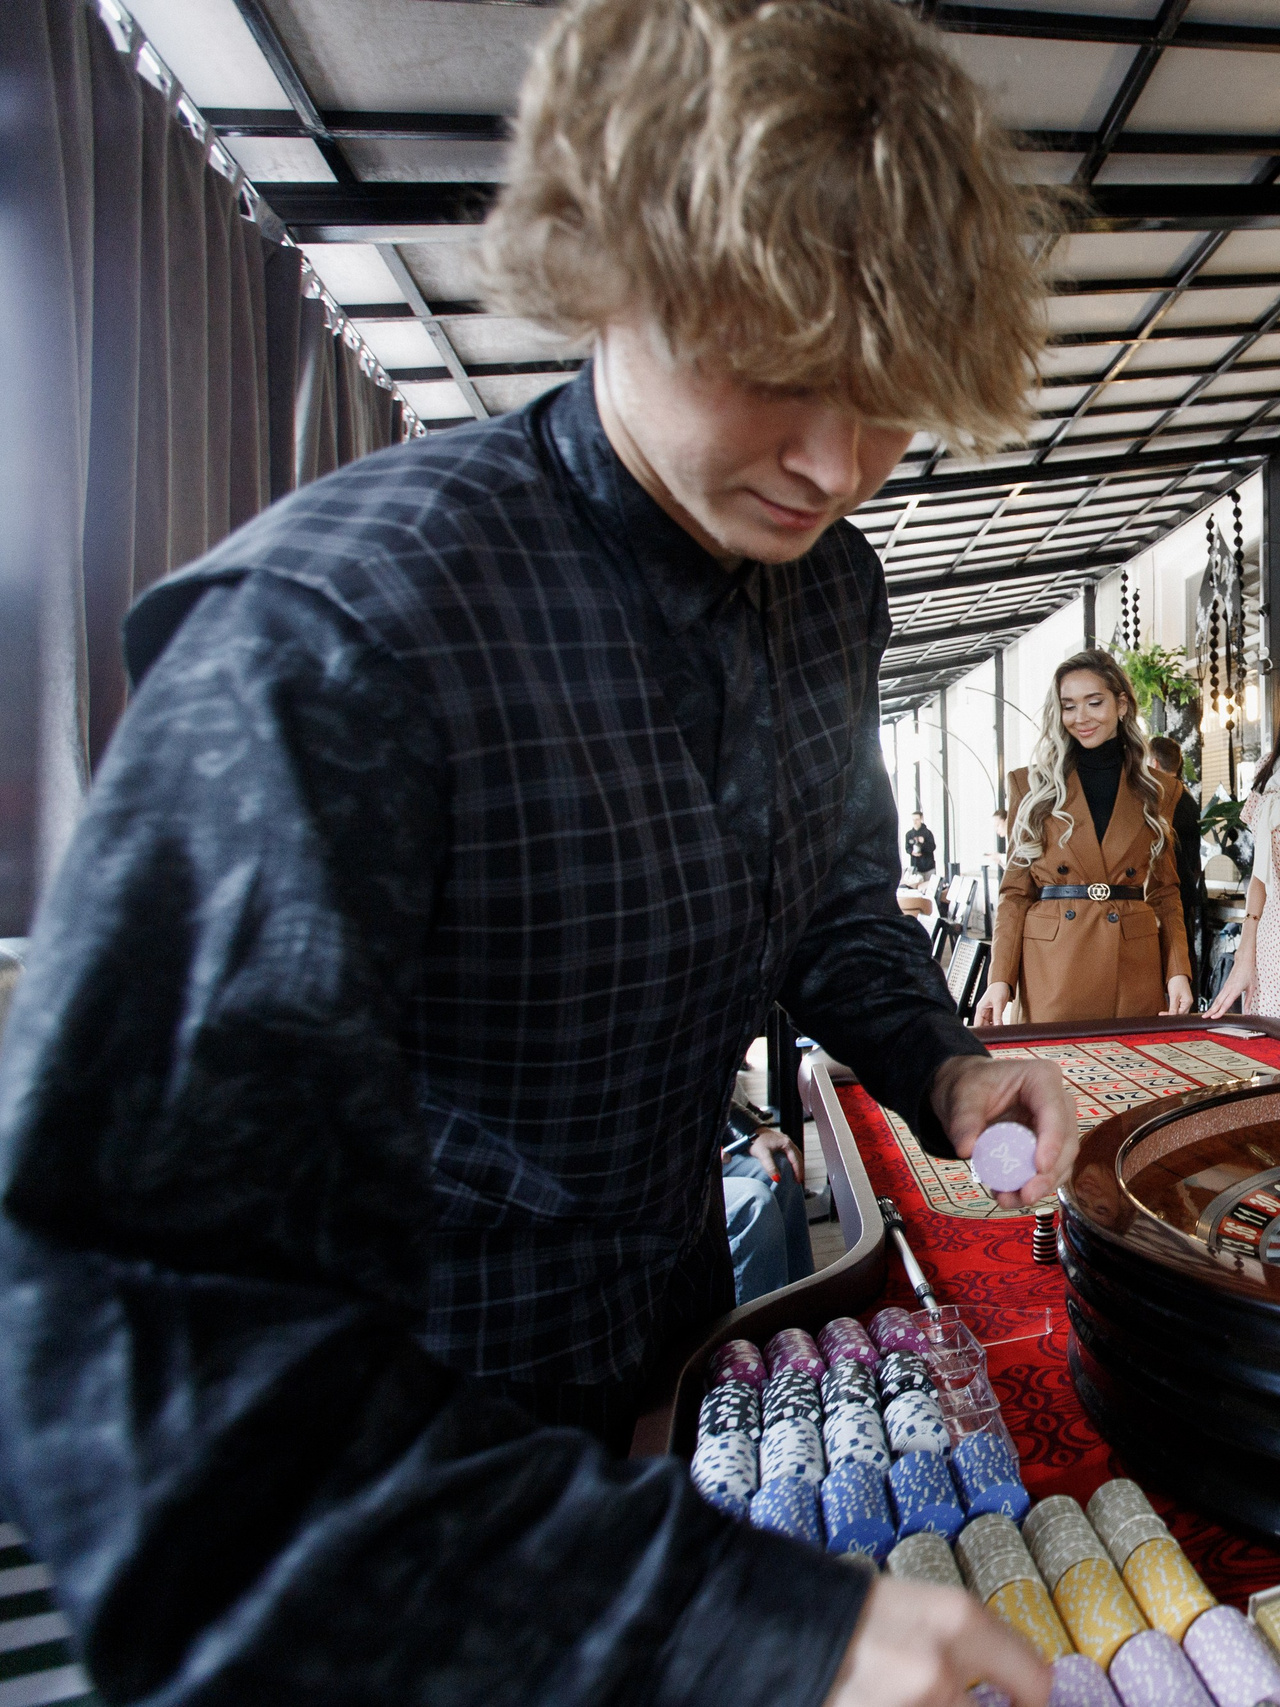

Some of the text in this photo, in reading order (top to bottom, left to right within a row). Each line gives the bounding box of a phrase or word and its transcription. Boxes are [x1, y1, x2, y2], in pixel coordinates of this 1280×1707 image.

[1077, 1074, 1117, 1082] 26
[1128, 1069, 1167, 1078] 25
[1143, 1077, 1183, 1086] 22
[1088, 1082, 1127, 1091] 23
[1104, 1091, 1146, 1101] 20
[1233, 1207, 1267, 1226] 11
[1223, 1222, 1257, 1240] 36
[1222, 1238, 1255, 1256] 13
